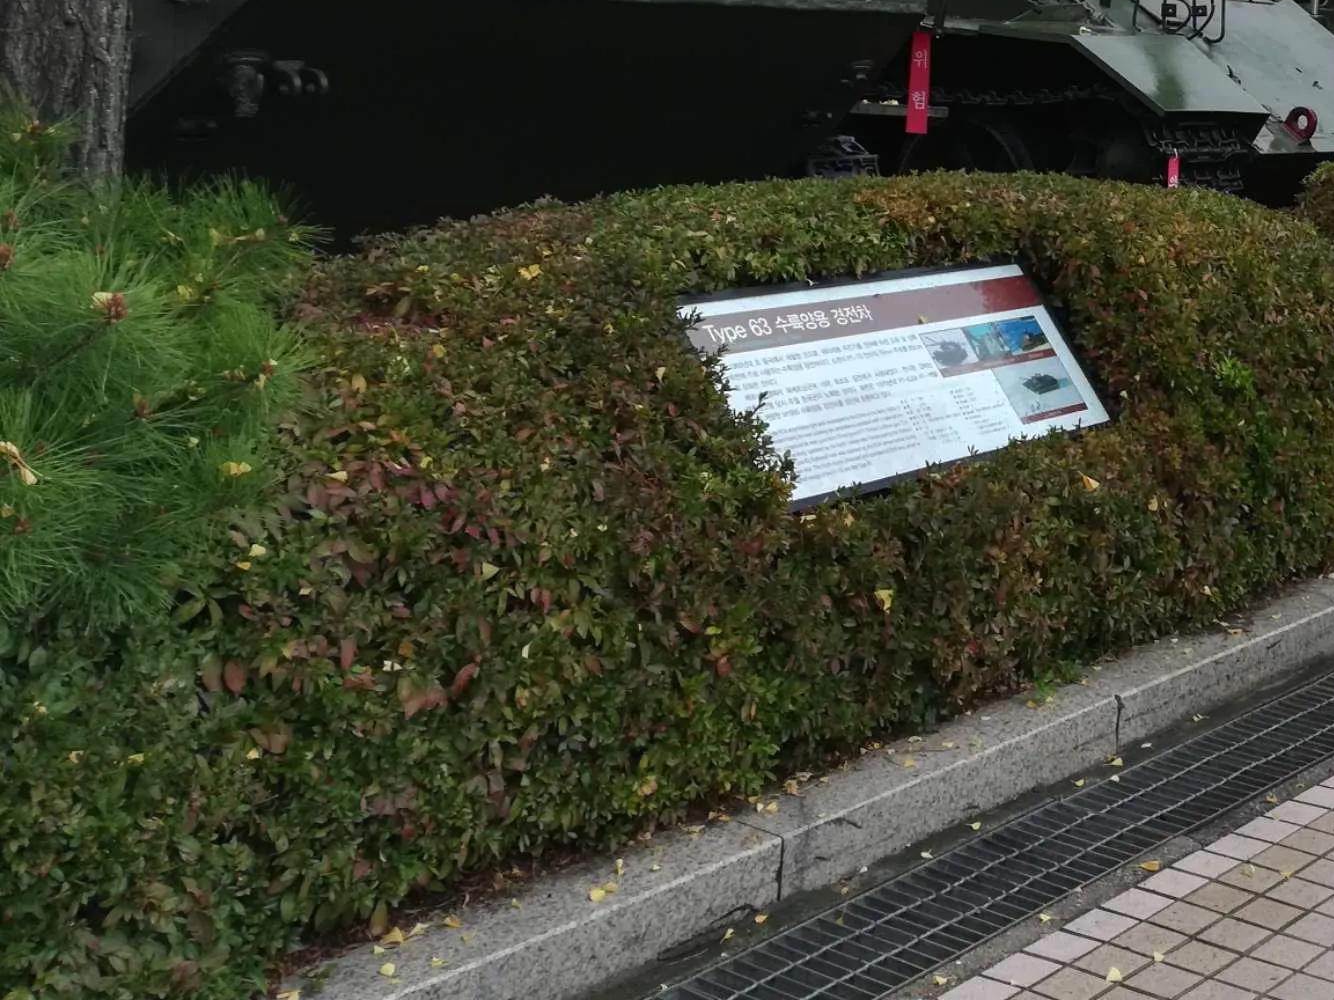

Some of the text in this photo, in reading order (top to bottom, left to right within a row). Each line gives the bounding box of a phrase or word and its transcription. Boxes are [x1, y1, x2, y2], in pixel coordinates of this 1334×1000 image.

[702, 301, 874, 344] Type 63 수륙양용 경전차
